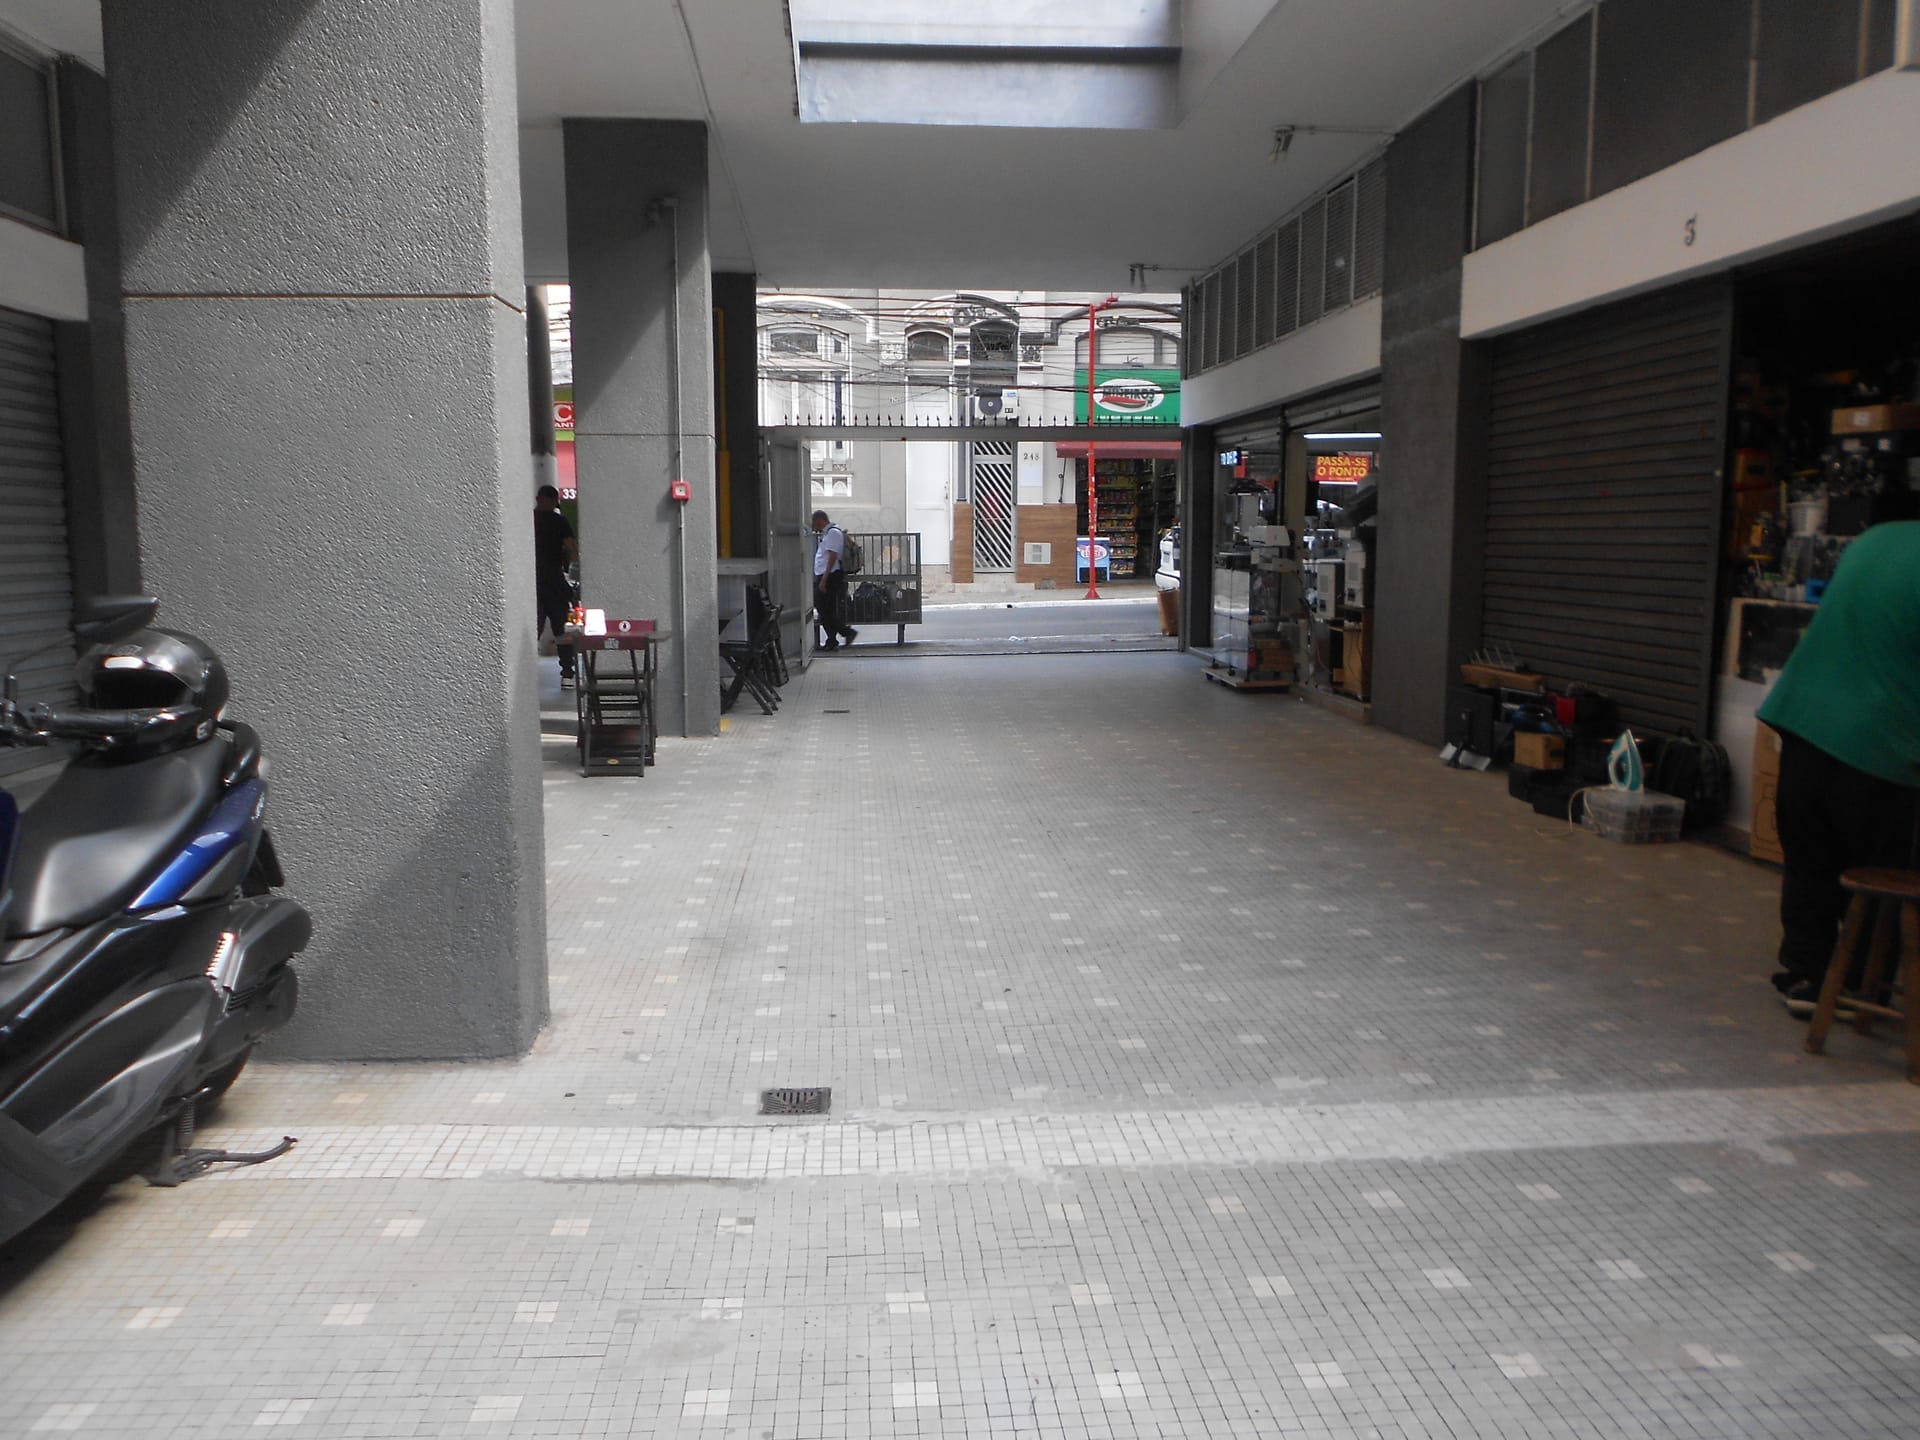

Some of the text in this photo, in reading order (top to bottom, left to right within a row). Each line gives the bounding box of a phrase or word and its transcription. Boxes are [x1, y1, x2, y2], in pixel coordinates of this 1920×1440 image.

[1317, 456, 1367, 466] PASSA-SE
[1317, 467, 1367, 477] O PONTO
